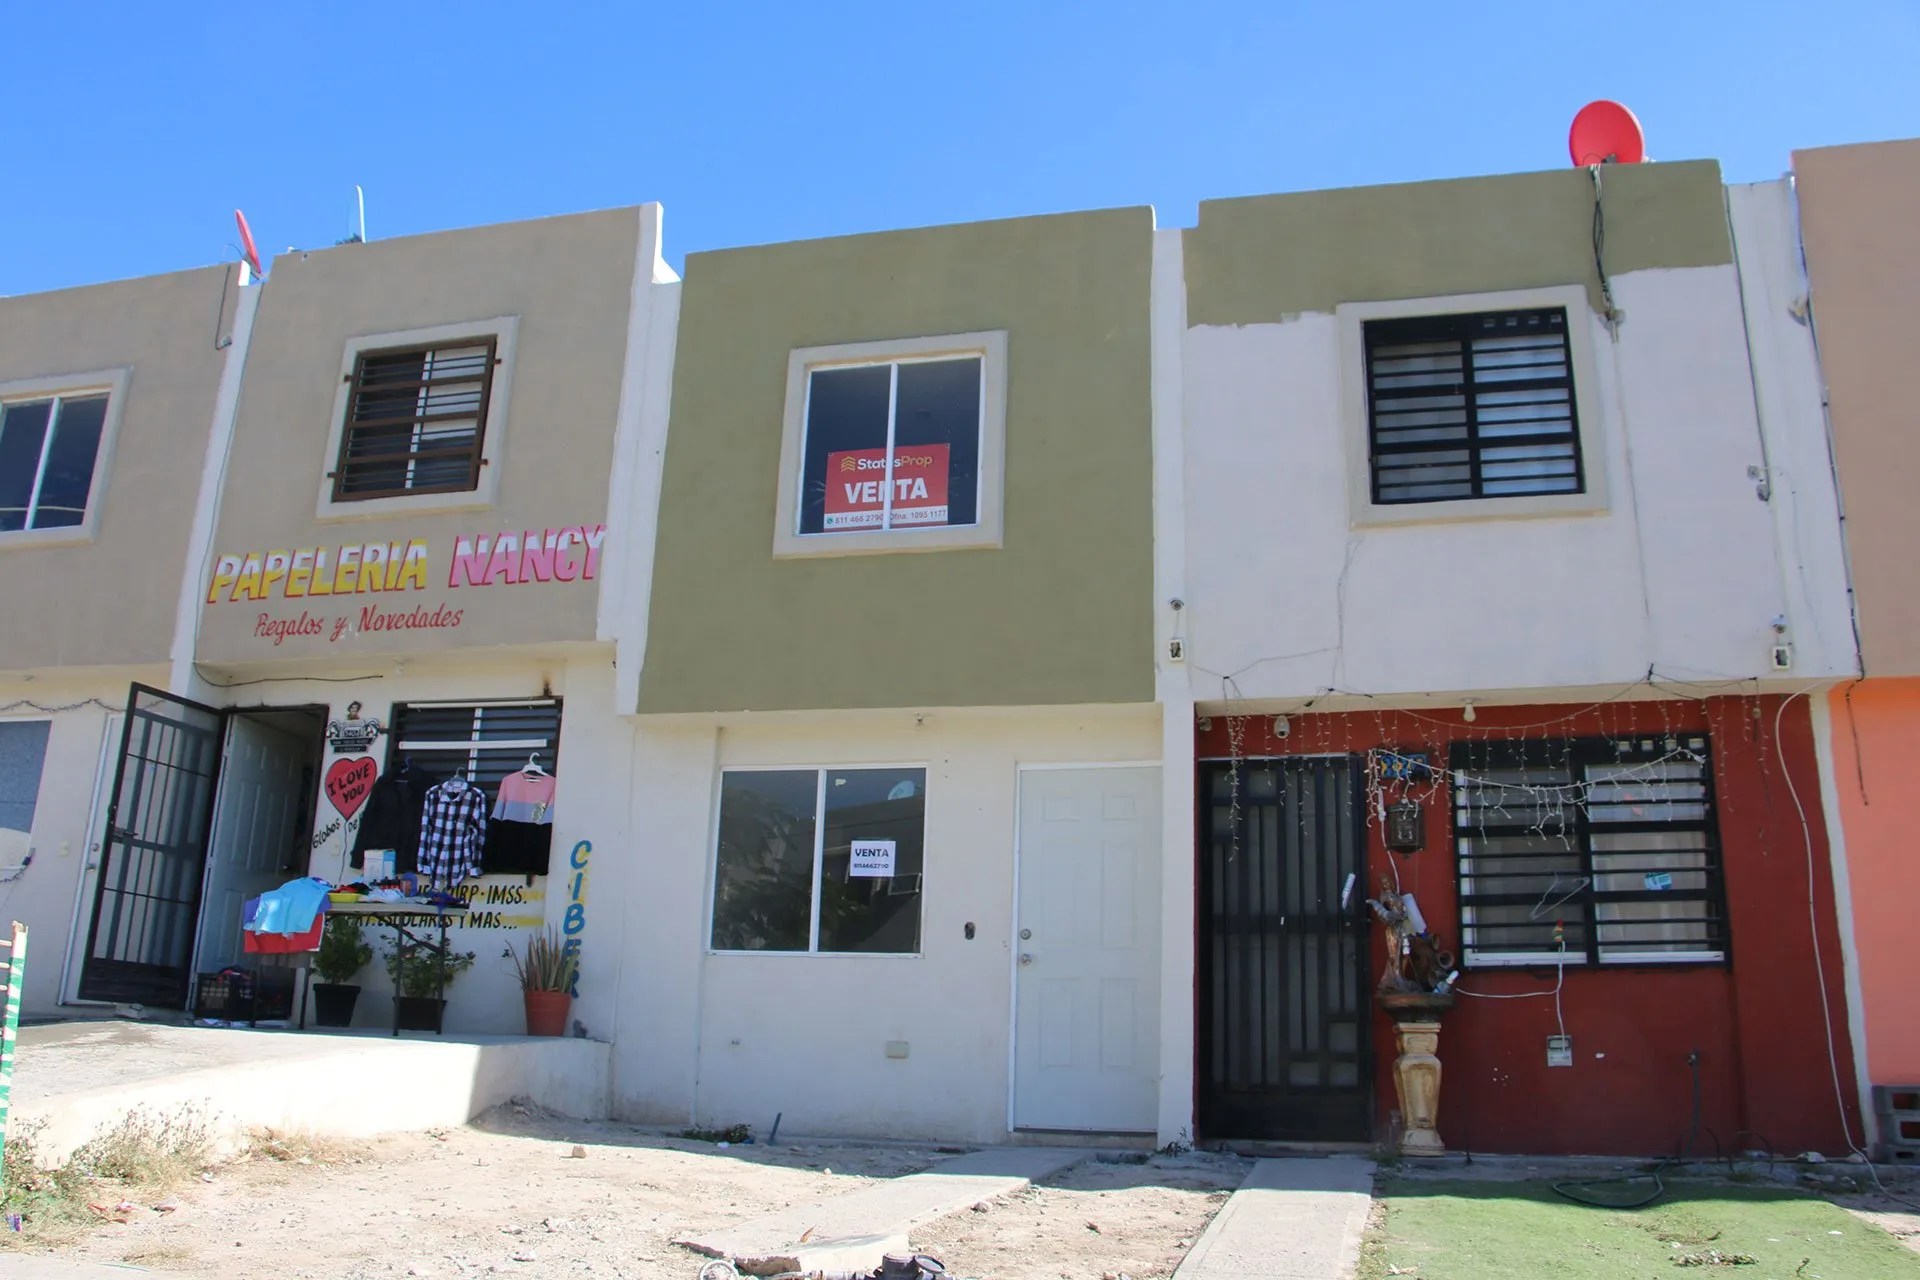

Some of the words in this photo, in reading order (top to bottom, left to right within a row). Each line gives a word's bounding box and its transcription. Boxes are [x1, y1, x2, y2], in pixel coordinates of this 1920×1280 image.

[857, 455, 933, 470] StatsProp
[844, 477, 928, 504] VENTA
[207, 538, 428, 603] PAPELERIA
[448, 525, 606, 588] NANCY
[254, 612, 322, 646] Regalos
[331, 615, 348, 641] y
[356, 603, 464, 633] Novedades
[337, 762, 370, 787] LOVE
[342, 783, 365, 804] YOU
[855, 848, 889, 857] VENTA
[449, 884, 480, 904] URP
